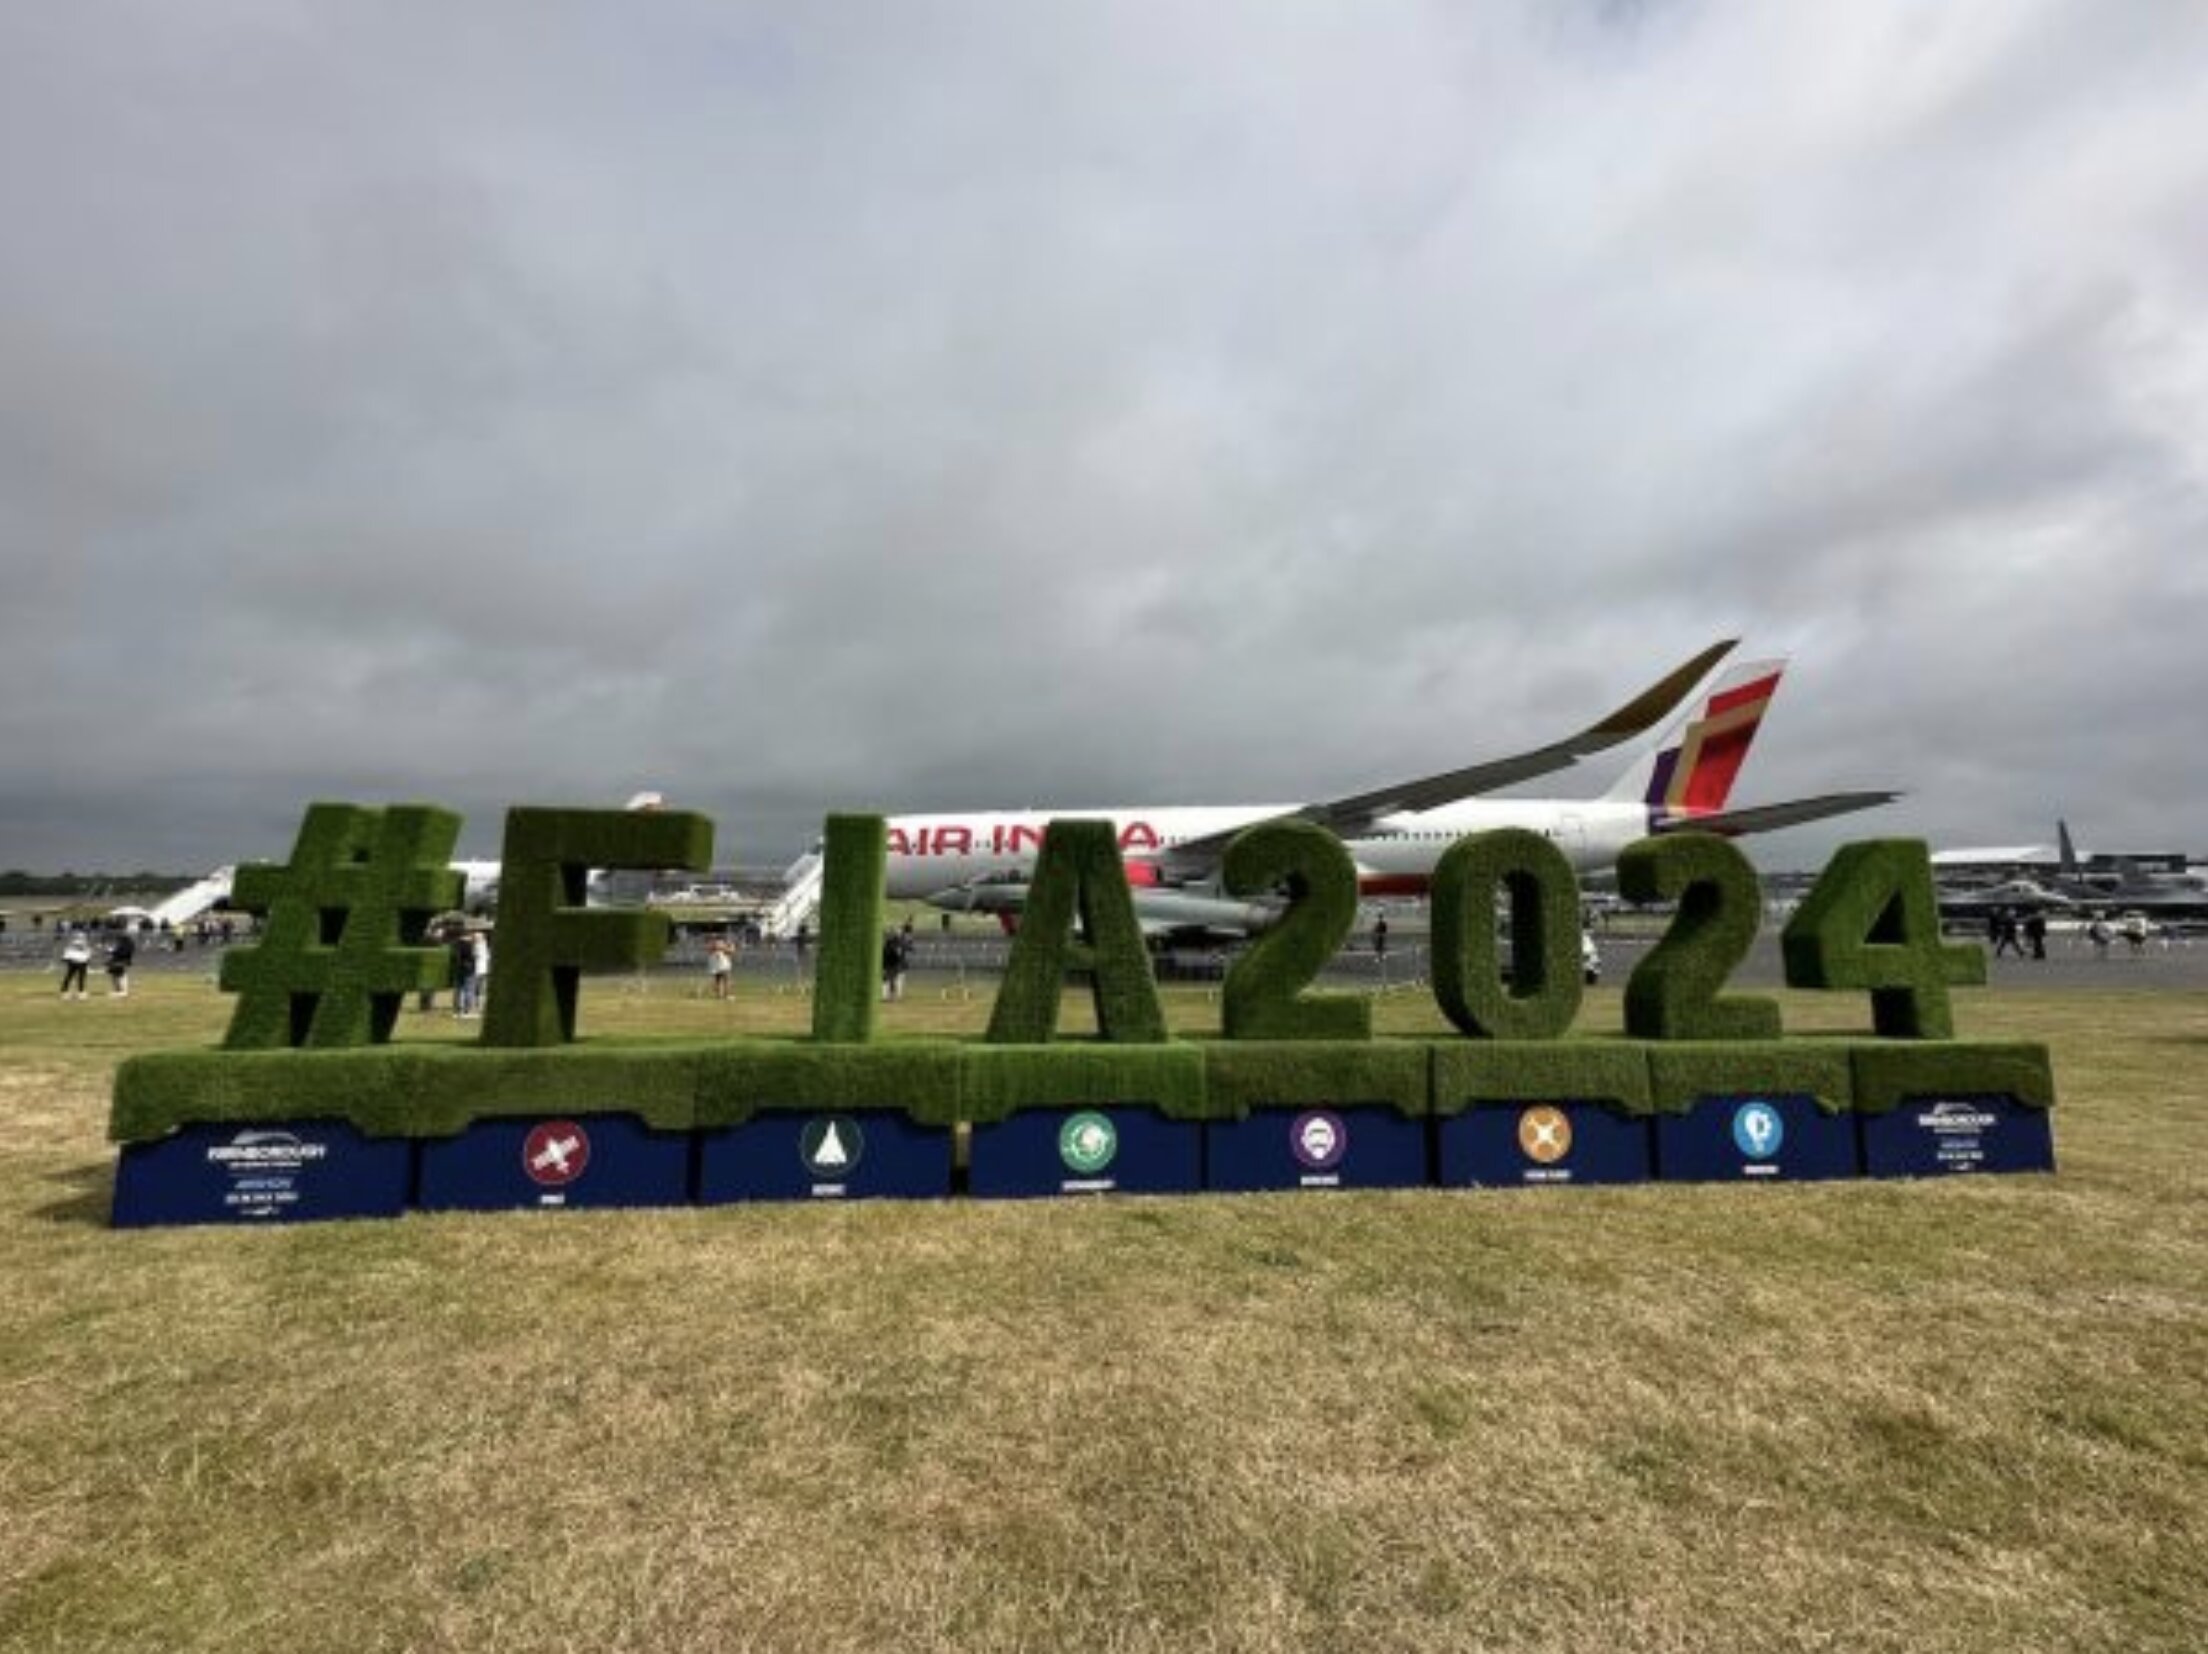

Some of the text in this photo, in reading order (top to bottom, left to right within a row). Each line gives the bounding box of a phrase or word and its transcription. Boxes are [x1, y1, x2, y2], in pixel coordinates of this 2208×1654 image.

[887, 821, 1157, 856] AIR INA
[219, 802, 1987, 1047] #FIA2024
